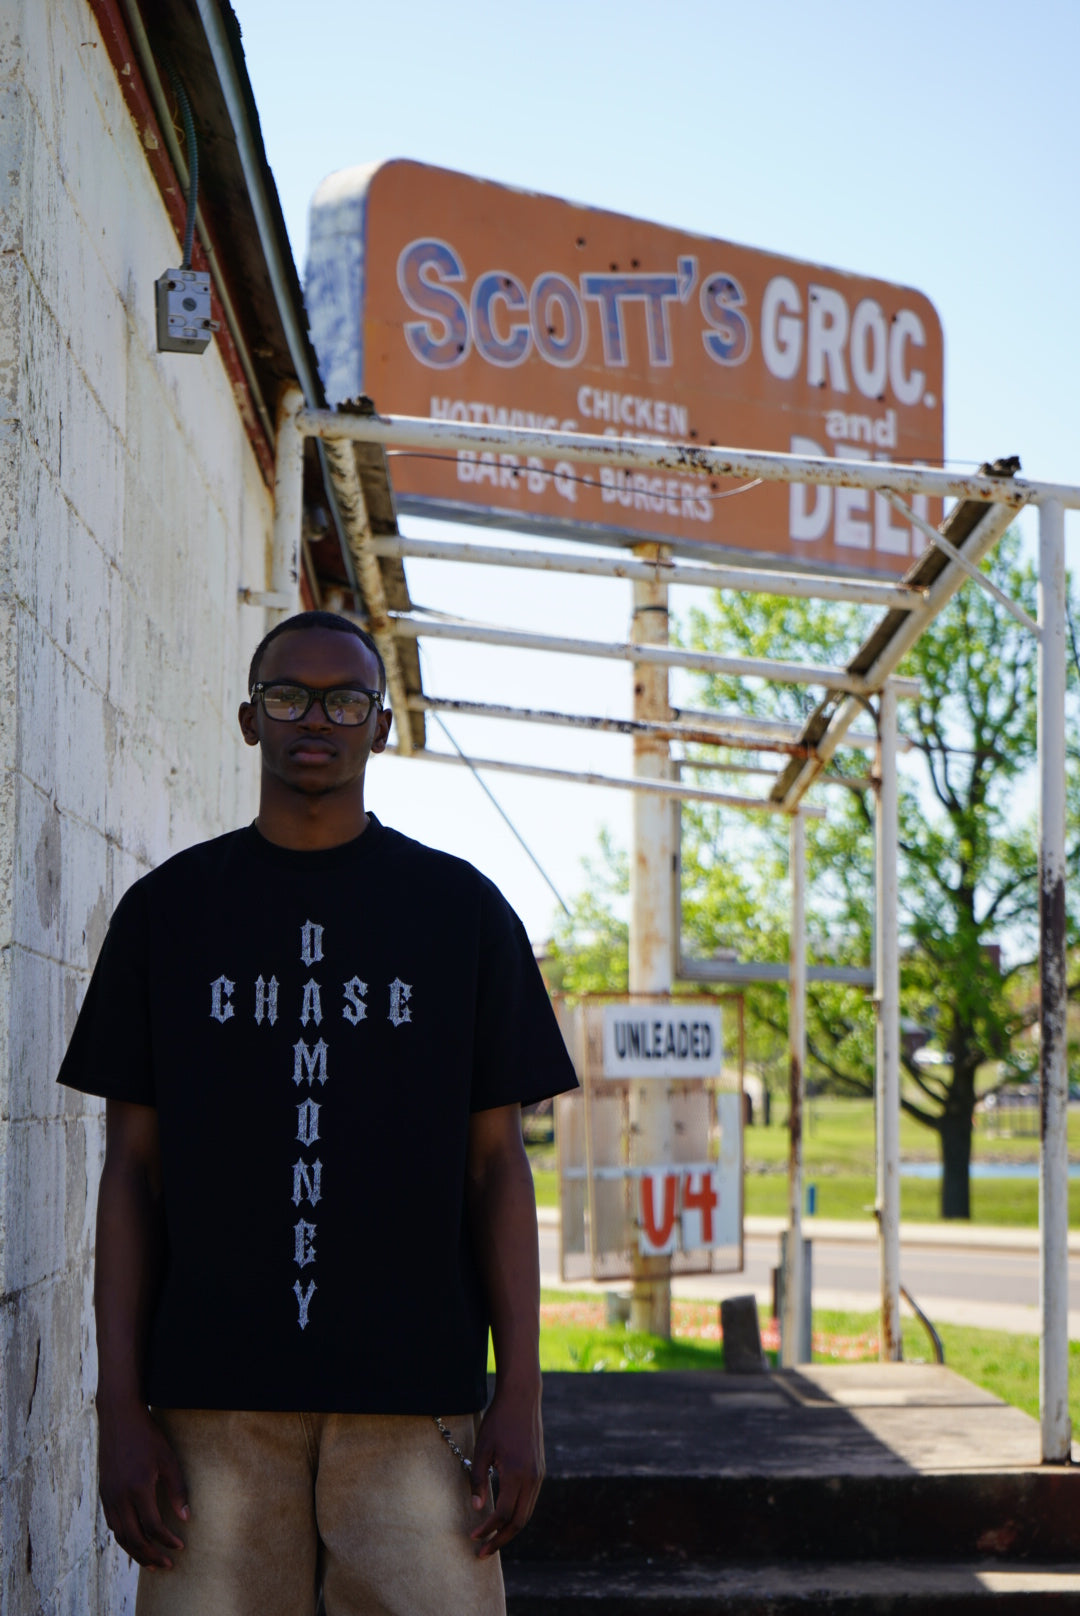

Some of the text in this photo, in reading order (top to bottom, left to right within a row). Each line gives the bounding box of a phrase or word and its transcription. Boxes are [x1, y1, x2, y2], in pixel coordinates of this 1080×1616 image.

[396, 237, 936, 408] SCOTT'S GROC.
[577, 386, 688, 436] CHICKEN
[825, 409, 897, 448] and
[599, 466, 714, 522] BURGERS
[209, 974, 414, 1027] CHASE
[613, 1020, 712, 1060] UNLEADED
